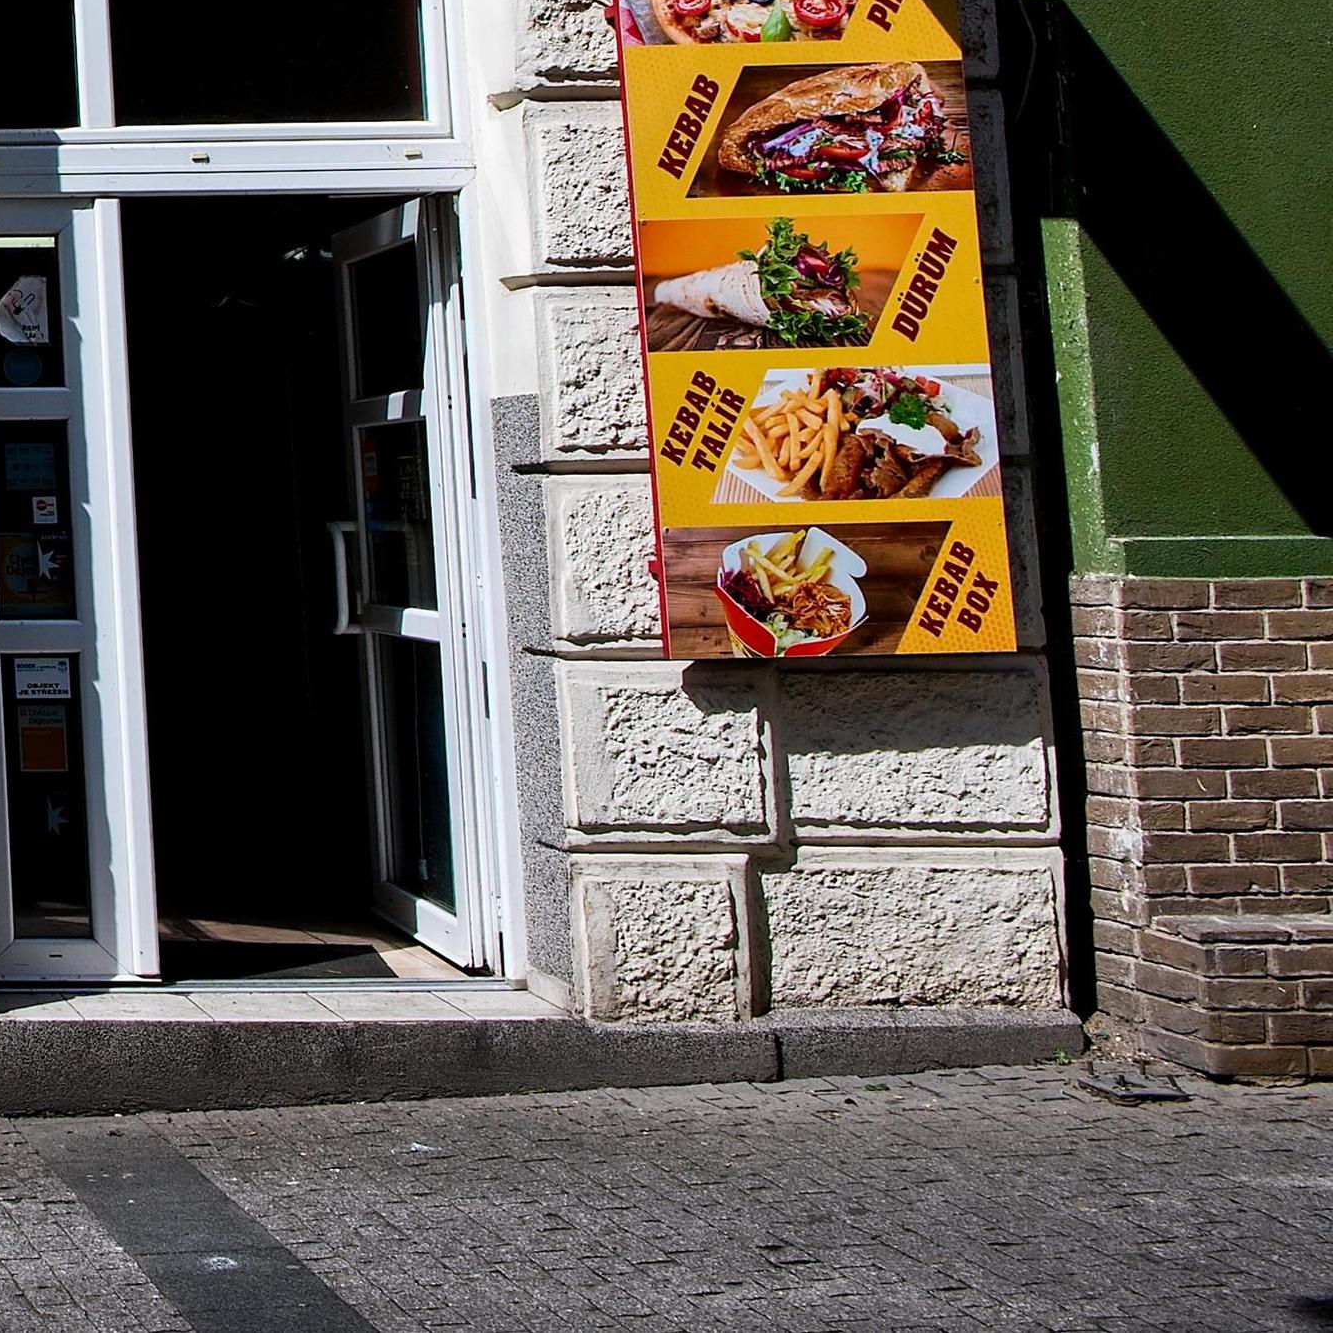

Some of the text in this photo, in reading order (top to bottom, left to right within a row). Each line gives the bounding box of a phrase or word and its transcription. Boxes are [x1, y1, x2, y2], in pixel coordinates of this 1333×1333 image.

[657, 73, 720, 180] KEBAB
[892, 227, 958, 342] DÜRÜM
[660, 370, 717, 467] KEBAB
[692, 386, 746, 473] TALÍŘ
[918, 540, 976, 638] KEBAB
[957, 571, 999, 633] BOX
